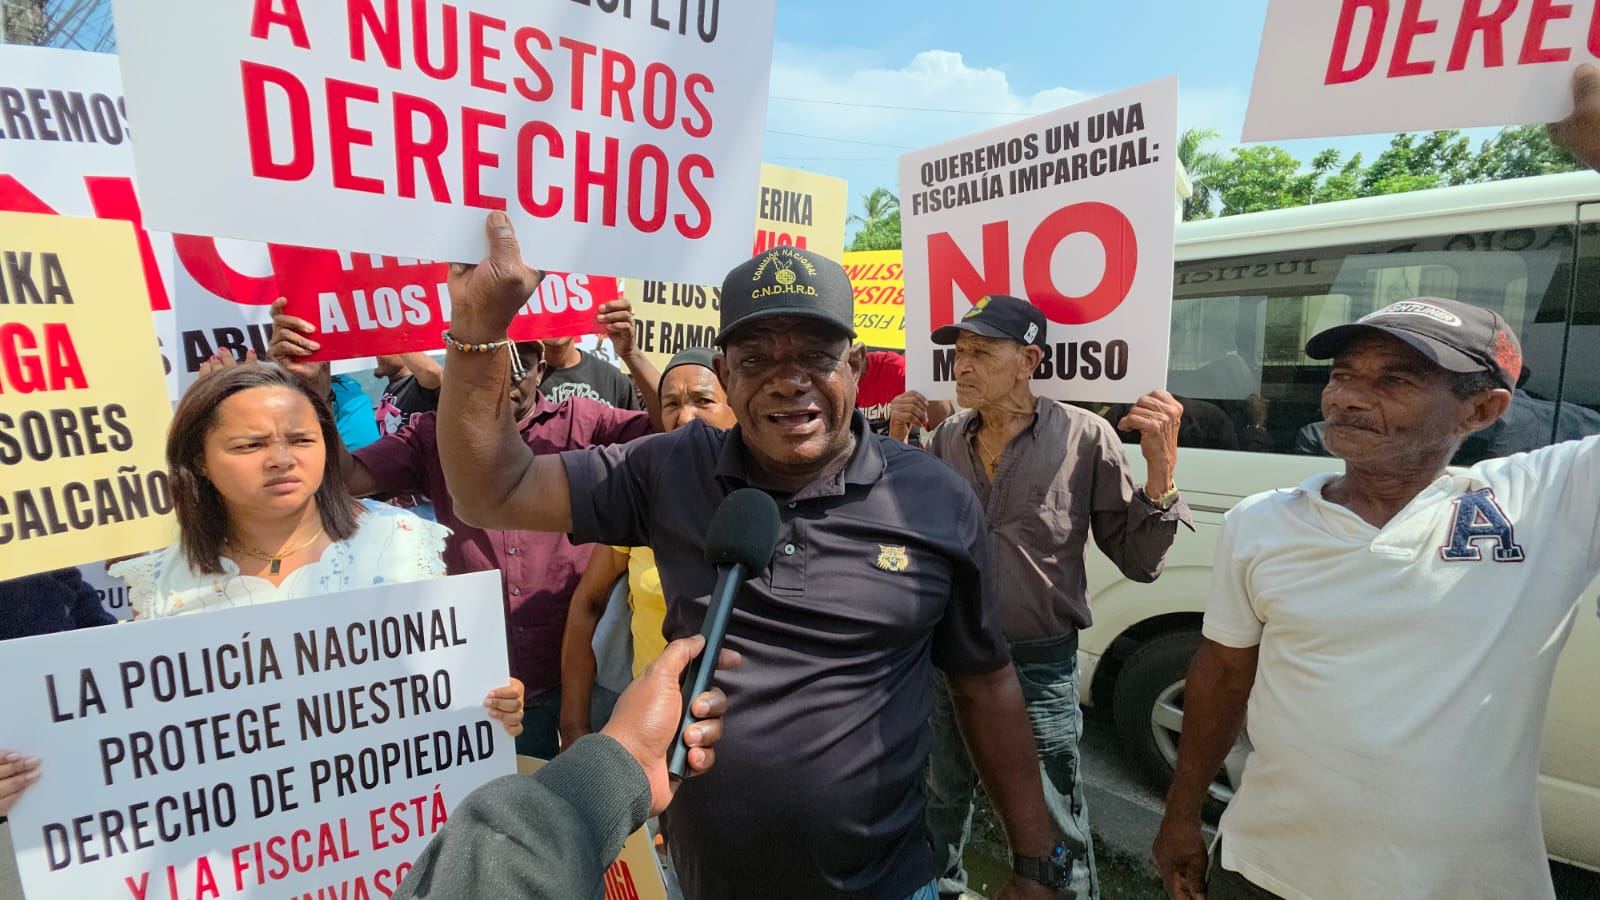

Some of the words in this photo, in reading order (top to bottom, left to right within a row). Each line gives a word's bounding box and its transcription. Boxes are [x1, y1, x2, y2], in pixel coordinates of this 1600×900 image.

[250, 0, 311, 49] A
[349, 0, 714, 138] NUESTROS
[1324, 0, 1600, 86] DERE
[0, 87, 131, 145] REMO
[240, 60, 714, 239] DERECHOS
[921, 133, 1039, 187] QUEREMOS
[1046, 121, 1080, 154] UN
[1087, 103, 1145, 143] UNA
[760, 186, 813, 226] ERIKA
[912, 173, 1004, 216] FISCALÍA
[1009, 137, 1160, 195] IMPARCIAL:
[752, 284, 819, 299] C.N.D.H.R.D.
[782, 249, 817, 276] NACIONAL
[927, 202, 1137, 332] NO
[318, 292, 349, 334] A
[352, 284, 431, 330] LOS
[659, 321, 721, 354] RAMO
[854, 313, 896, 330] FISC
[0, 322, 89, 394] GA
[1030, 340, 1129, 381] BUSO
[1439, 487, 1525, 562] A
[44, 673, 106, 724] LA
[119, 632, 283, 709] POLICÍA
[294, 606, 468, 675] NACIONAL
[99, 702, 285, 786] PROTEGE
[297, 668, 452, 741] NUESTRO
[42, 782, 236, 872] DERECHO
[250, 766, 299, 820] DE
[310, 720, 495, 803] PROPIEDAD
[166, 855, 220, 900] LA
[232, 818, 360, 891] FISCAL
[369, 783, 448, 851] ESTÁ
